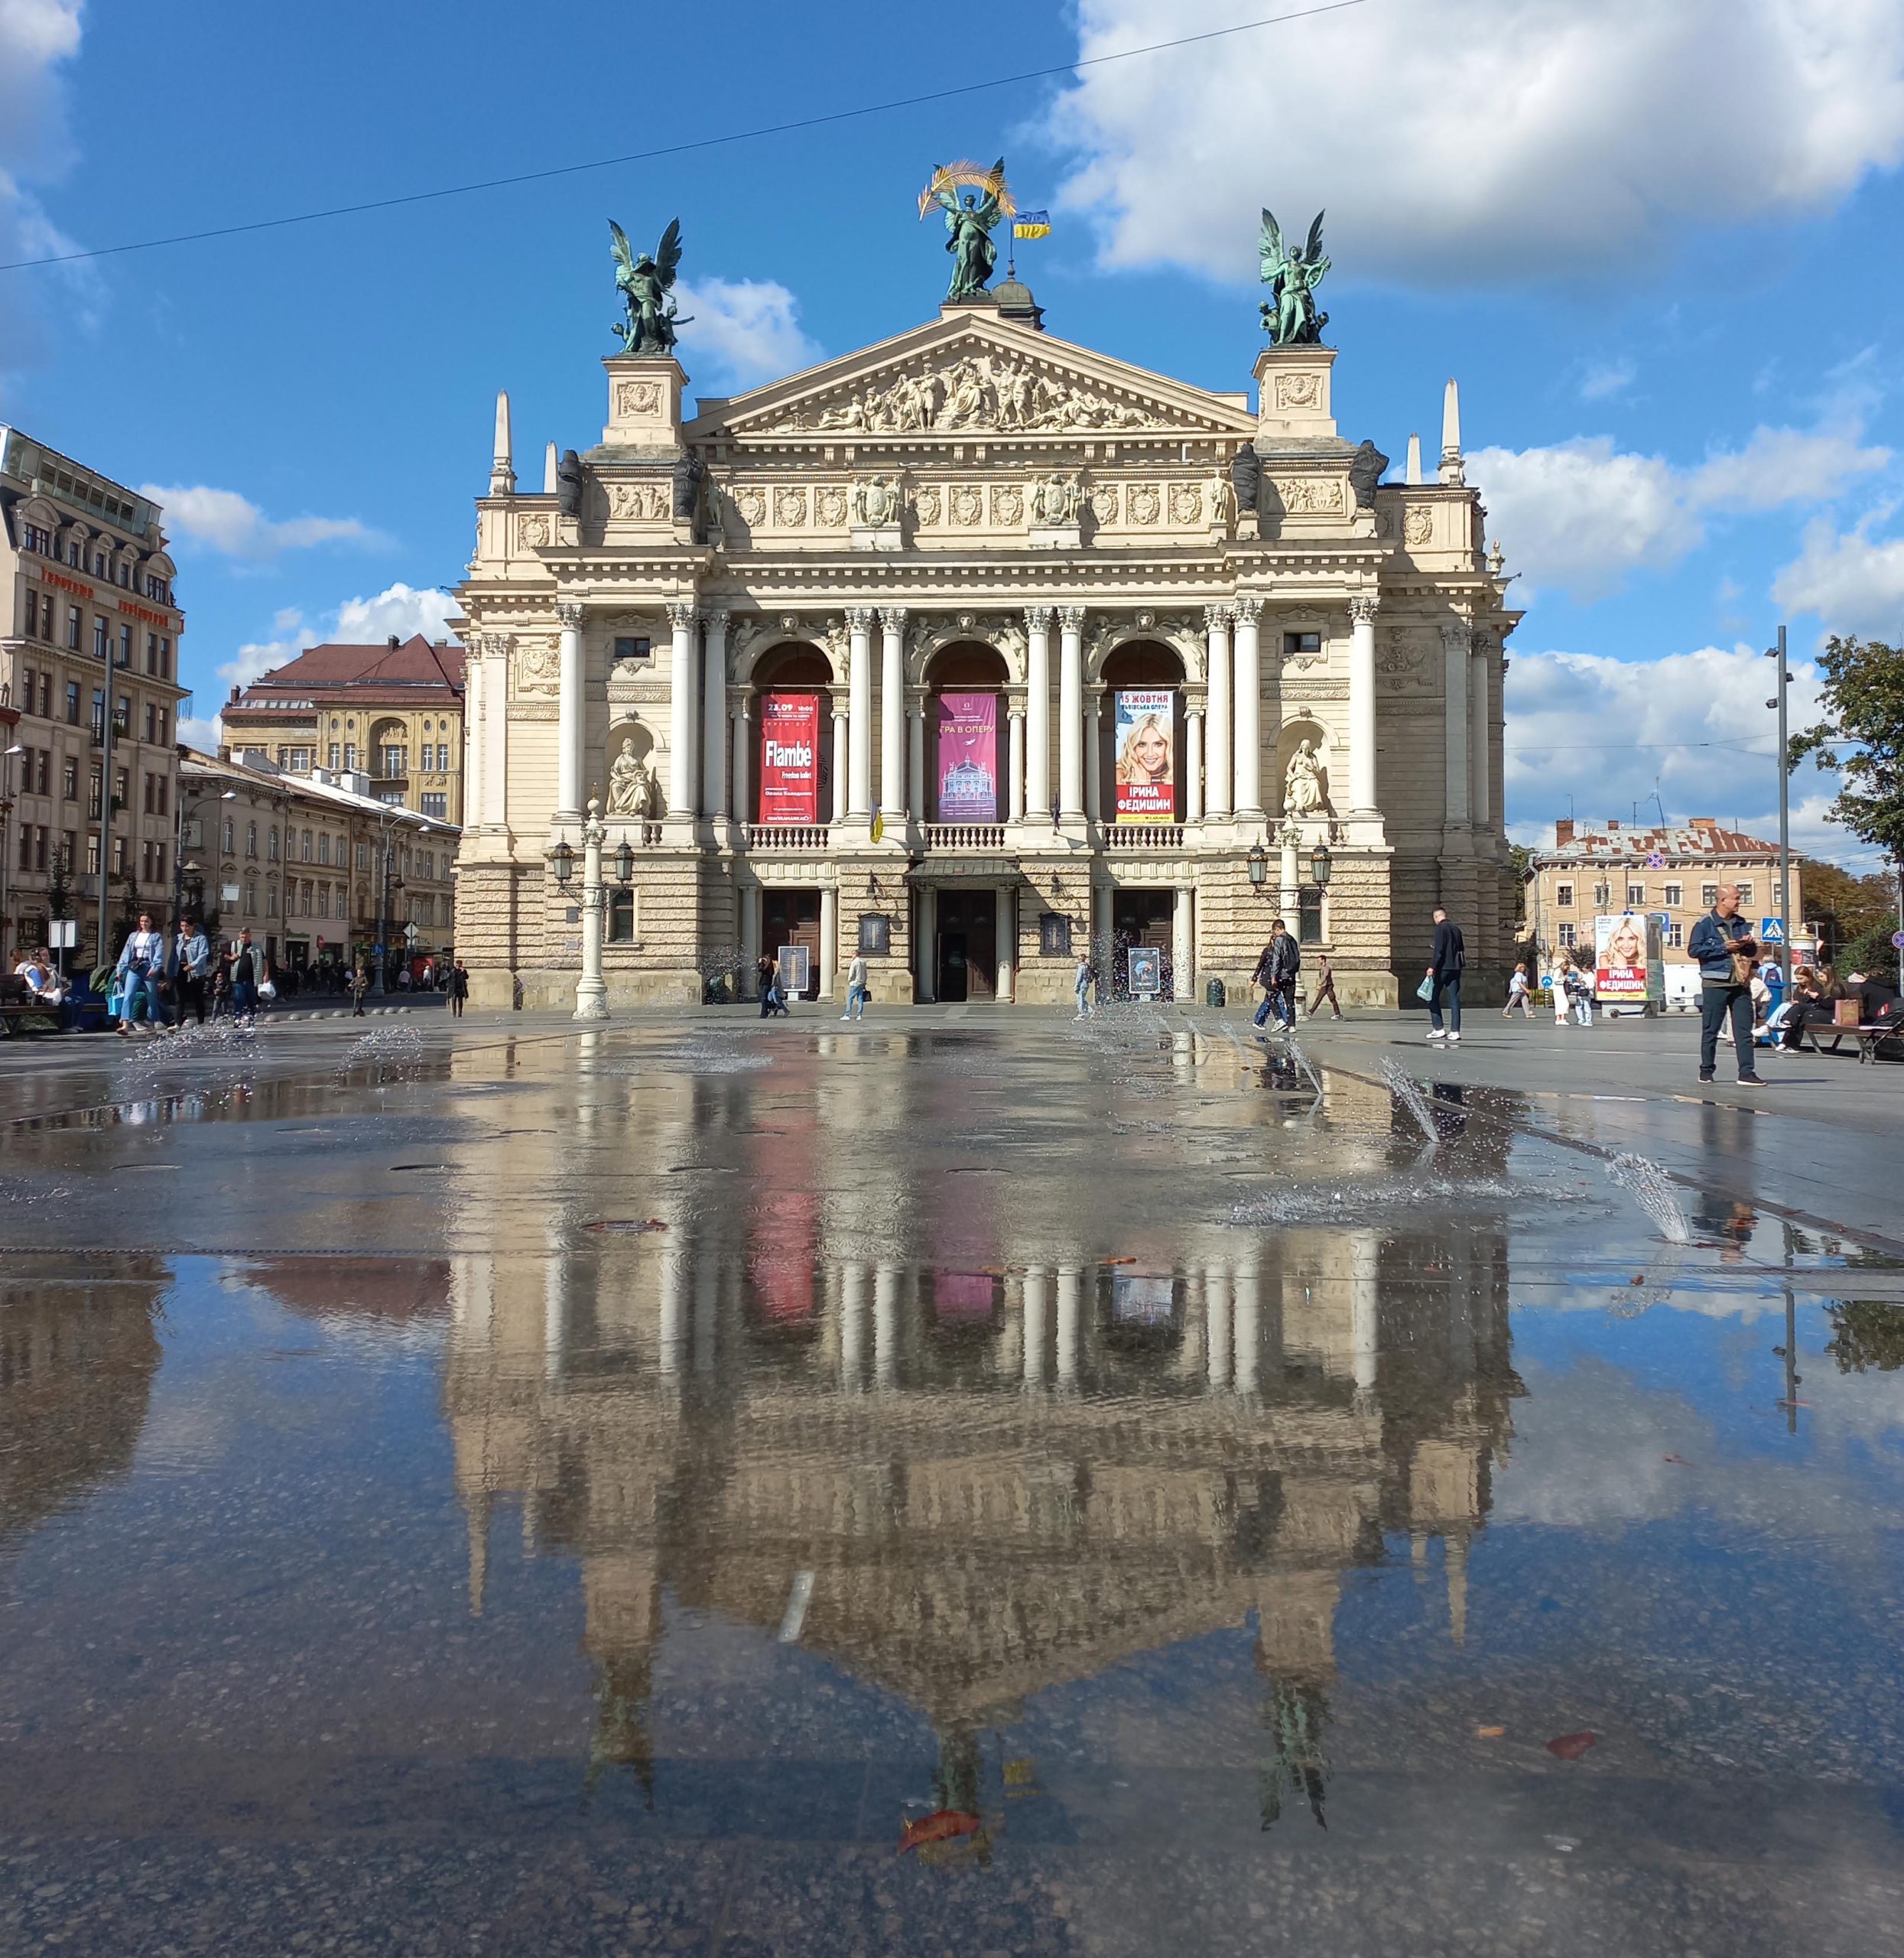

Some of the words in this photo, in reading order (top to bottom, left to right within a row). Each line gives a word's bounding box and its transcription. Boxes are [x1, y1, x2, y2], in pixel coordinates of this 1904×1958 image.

[1121, 694, 1129, 703] 15
[1132, 694, 1168, 703] ЖОВТНЯ
[940, 725, 956, 733] ГРА
[957, 725, 963, 733] В
[965, 725, 994, 733] ОПЕРУ
[765, 740, 811, 767] Flambé
[1129, 786, 1159, 797] ІРИНА
[1117, 799, 1171, 811] ФЕДИШИН
[1609, 969, 1634, 979] ІРИНА
[1600, 980, 1644, 990] ФЕДИШИН
